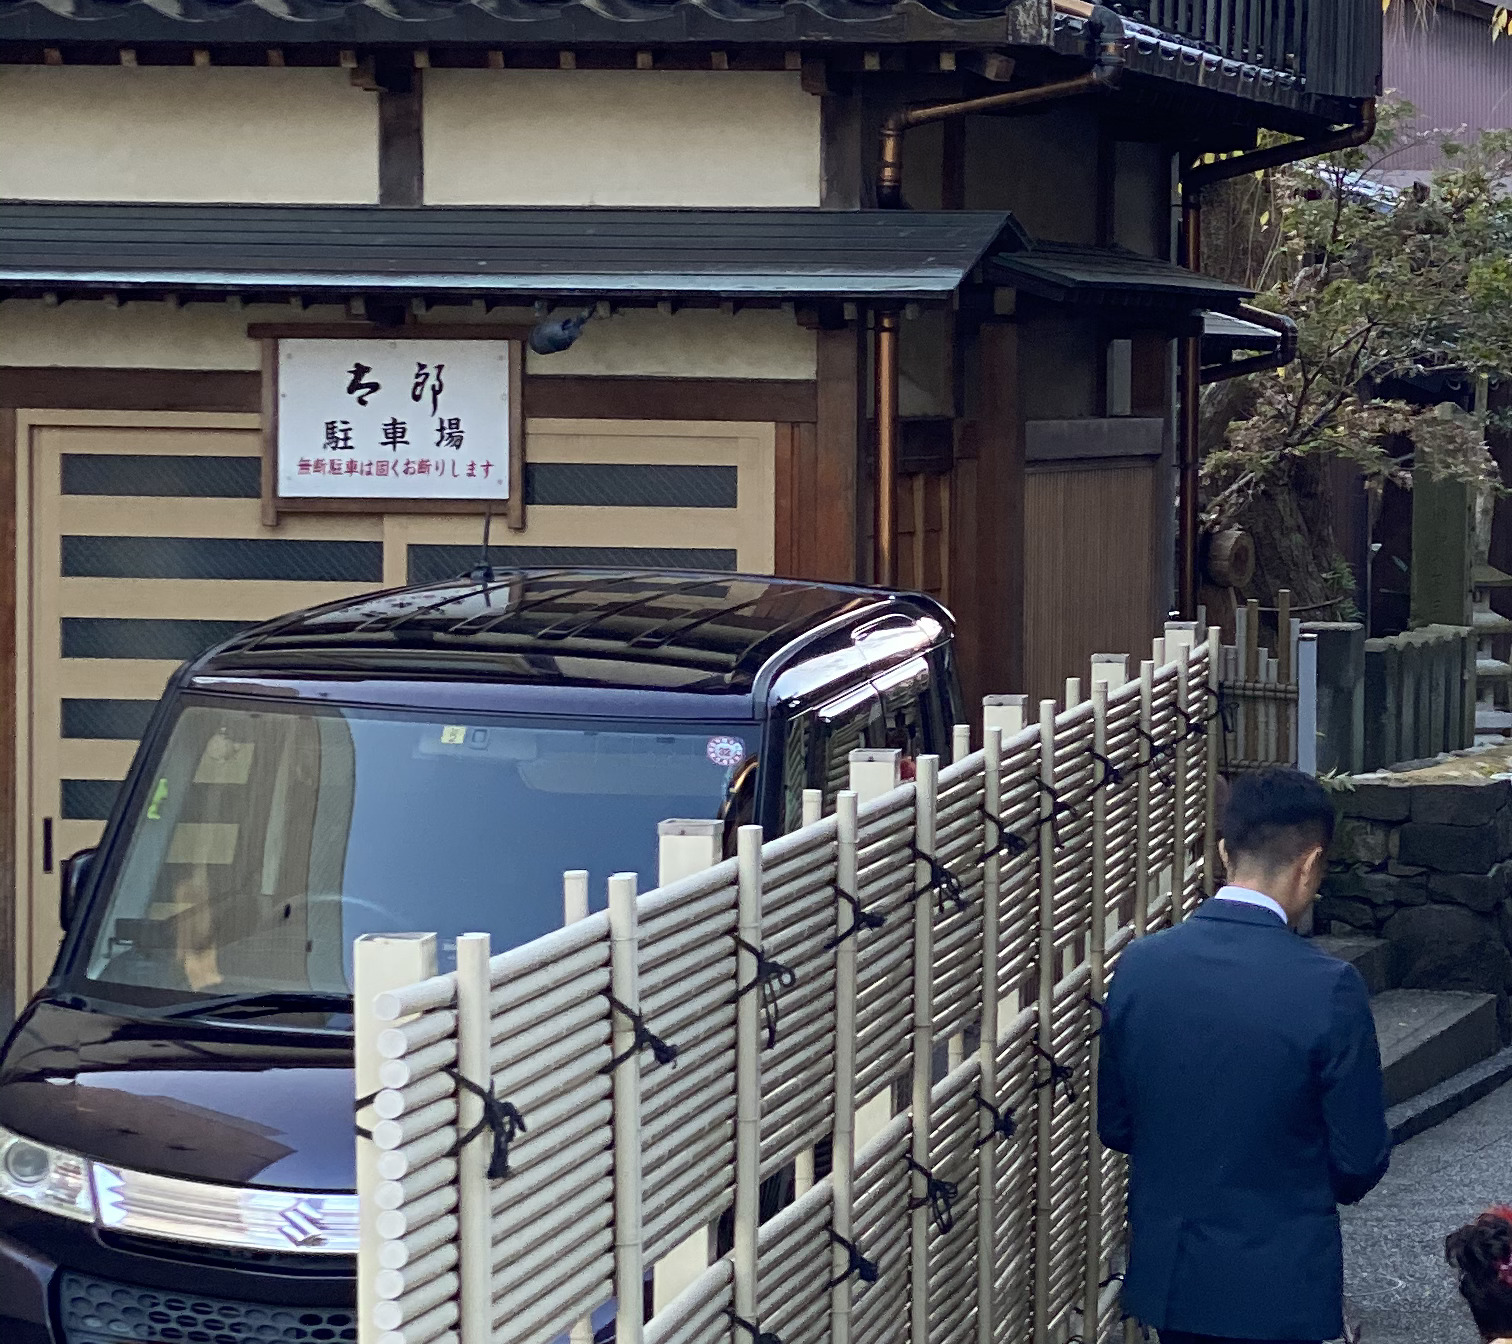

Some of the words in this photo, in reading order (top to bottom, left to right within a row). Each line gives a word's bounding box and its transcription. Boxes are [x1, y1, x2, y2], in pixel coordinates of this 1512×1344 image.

[323, 417, 465, 452] 駐車場
[296, 457, 495, 479] 無断駐車は固くお断りします
